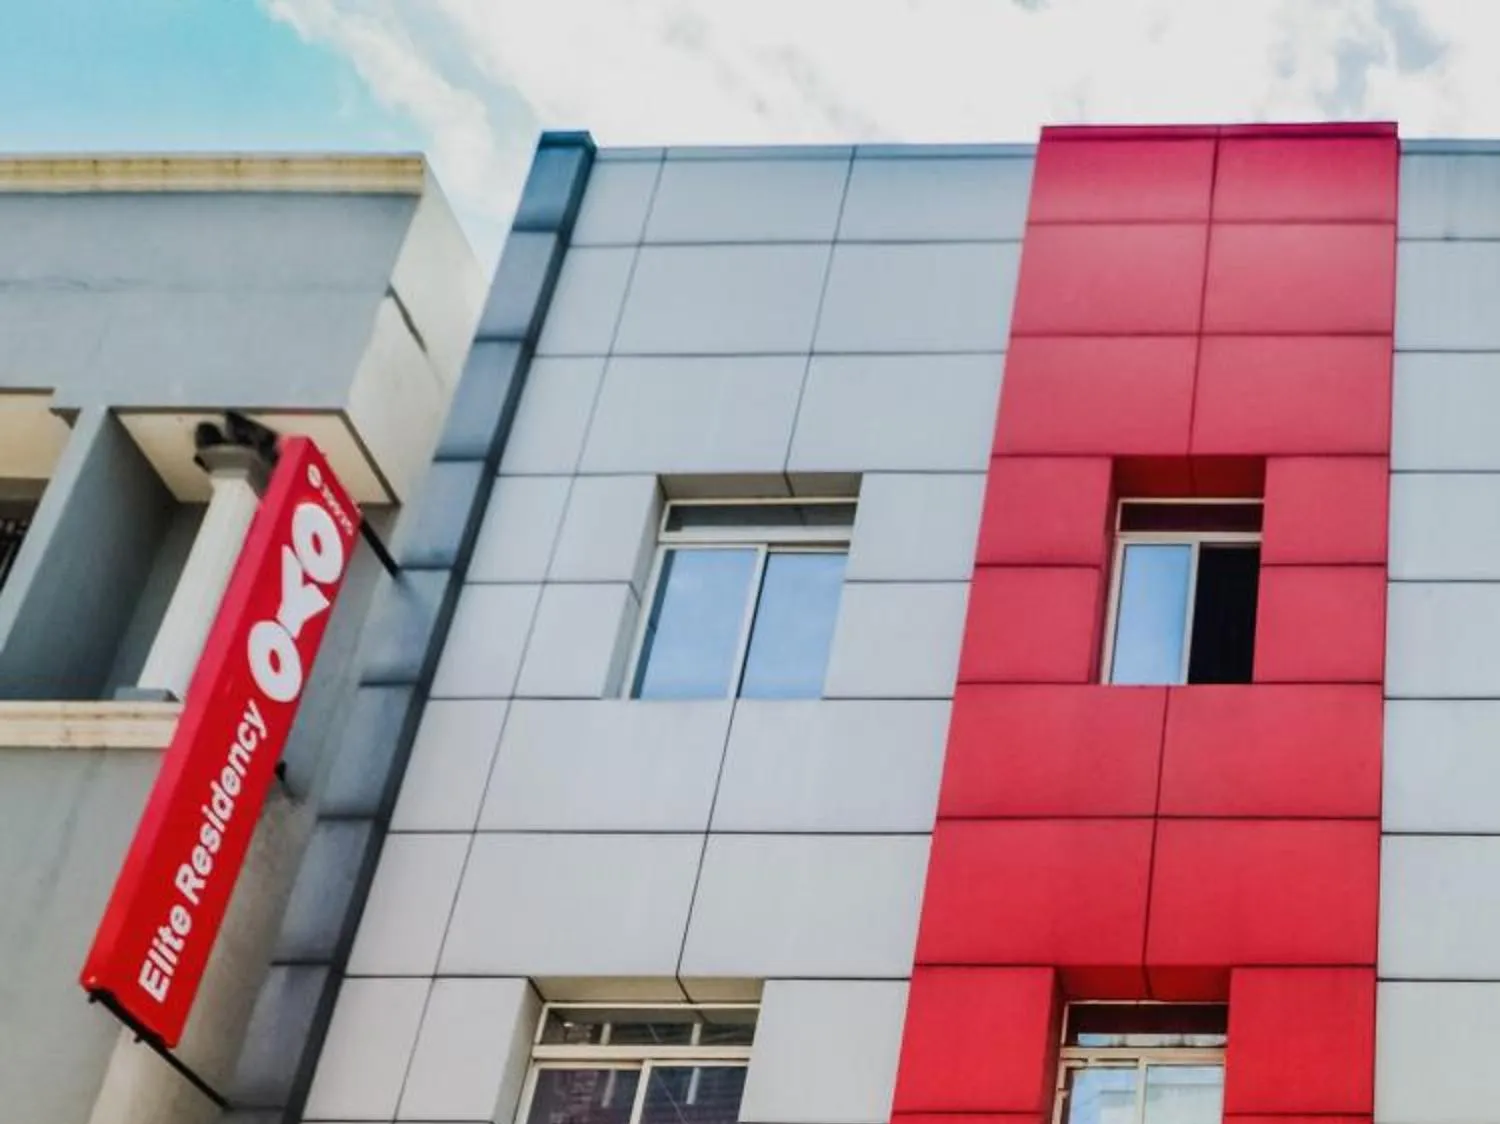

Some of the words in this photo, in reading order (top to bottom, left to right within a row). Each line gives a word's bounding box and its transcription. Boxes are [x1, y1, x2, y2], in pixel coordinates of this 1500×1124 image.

[247, 501, 345, 702] OYO
[138, 901, 192, 1004] Elite
[174, 698, 268, 905] Residency
